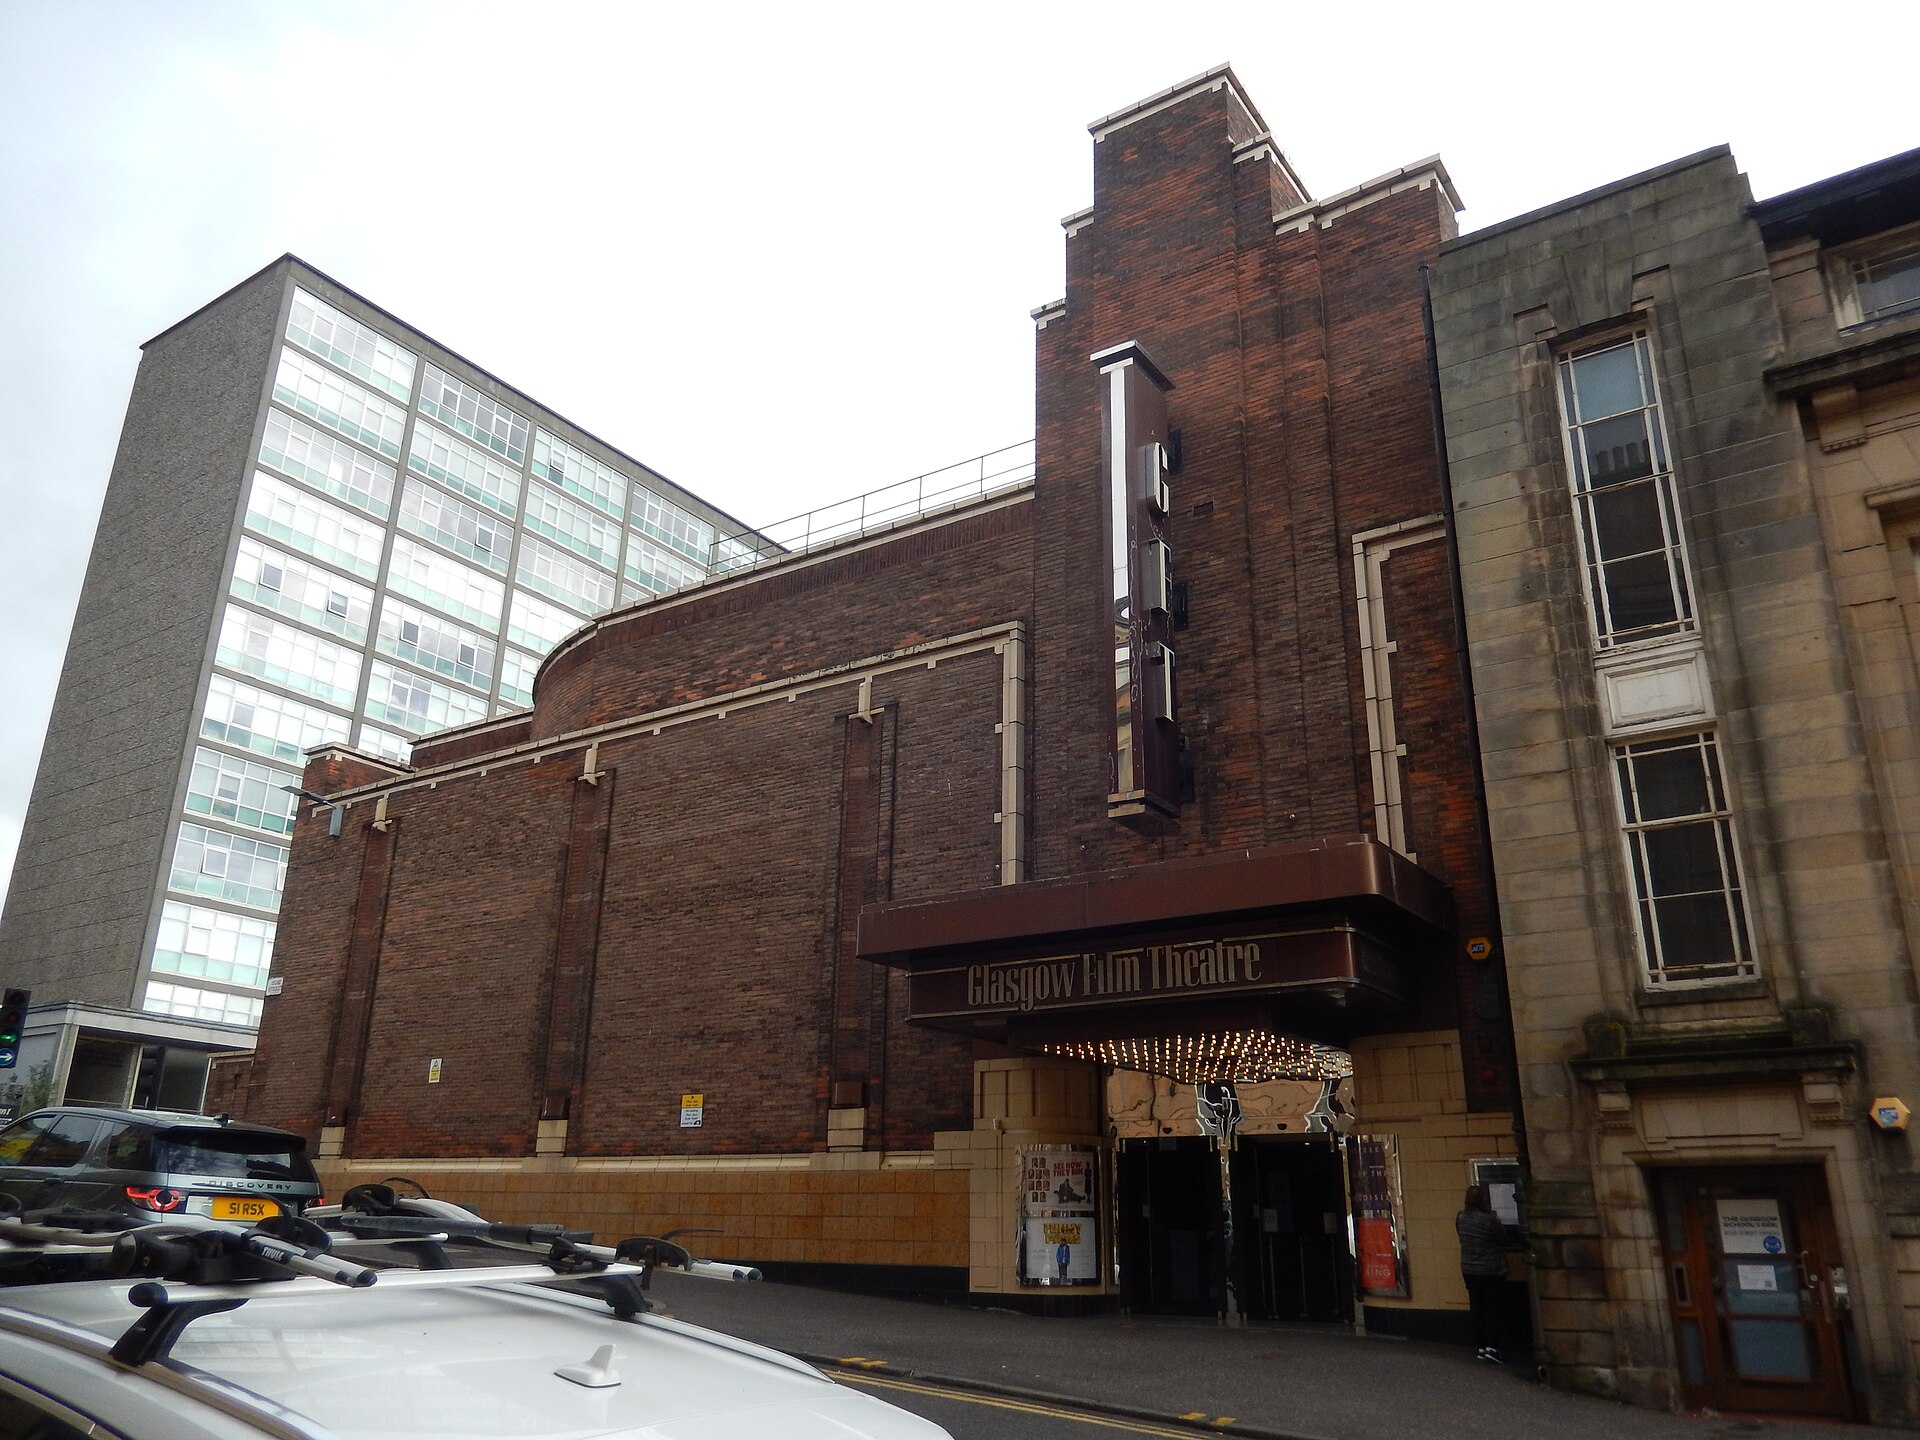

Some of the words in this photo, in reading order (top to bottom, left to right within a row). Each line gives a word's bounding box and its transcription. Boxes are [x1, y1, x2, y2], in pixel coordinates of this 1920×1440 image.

[967, 962, 1076, 1012] Glasgow
[1081, 952, 1142, 997] Film
[1147, 942, 1262, 989] Theatre
[1053, 1162, 1065, 1170] SEE
[1065, 1161, 1082, 1169] HOW
[1053, 1169, 1070, 1177] THEY
[208, 1180, 292, 1191] DISCOVERY
[242, 1203, 265, 1216] RSX
[261, 1246, 285, 1262] THULE
[1365, 1268, 1391, 1277] KING
